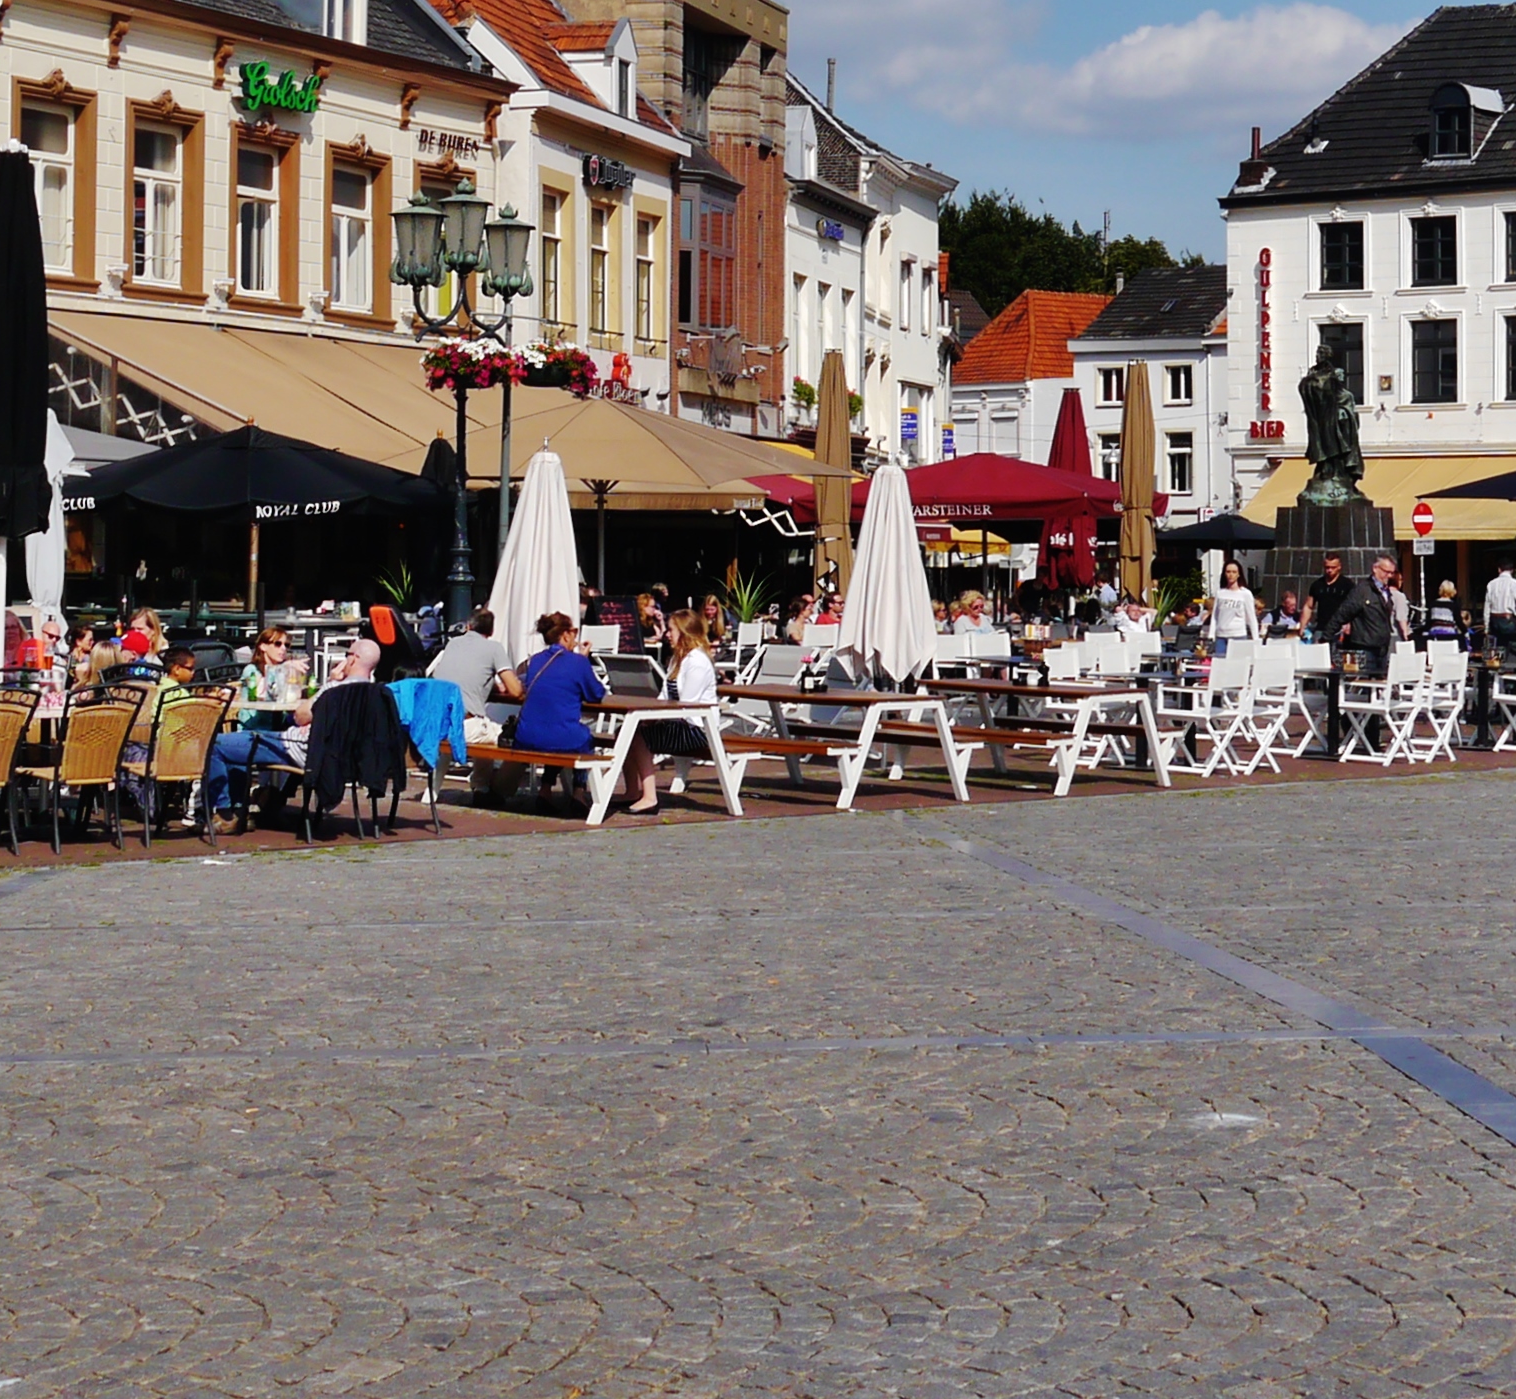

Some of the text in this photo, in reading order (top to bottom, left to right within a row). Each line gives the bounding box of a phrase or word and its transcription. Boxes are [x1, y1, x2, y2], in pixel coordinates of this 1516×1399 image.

[243, 61, 319, 112] Grolsch
[419, 129, 436, 145] DE
[1259, 248, 1272, 413] GULPENER
[1250, 421, 1285, 439] BIER
[305, 501, 341, 515] CLUB
[911, 505, 992, 516] ARSTEINER
